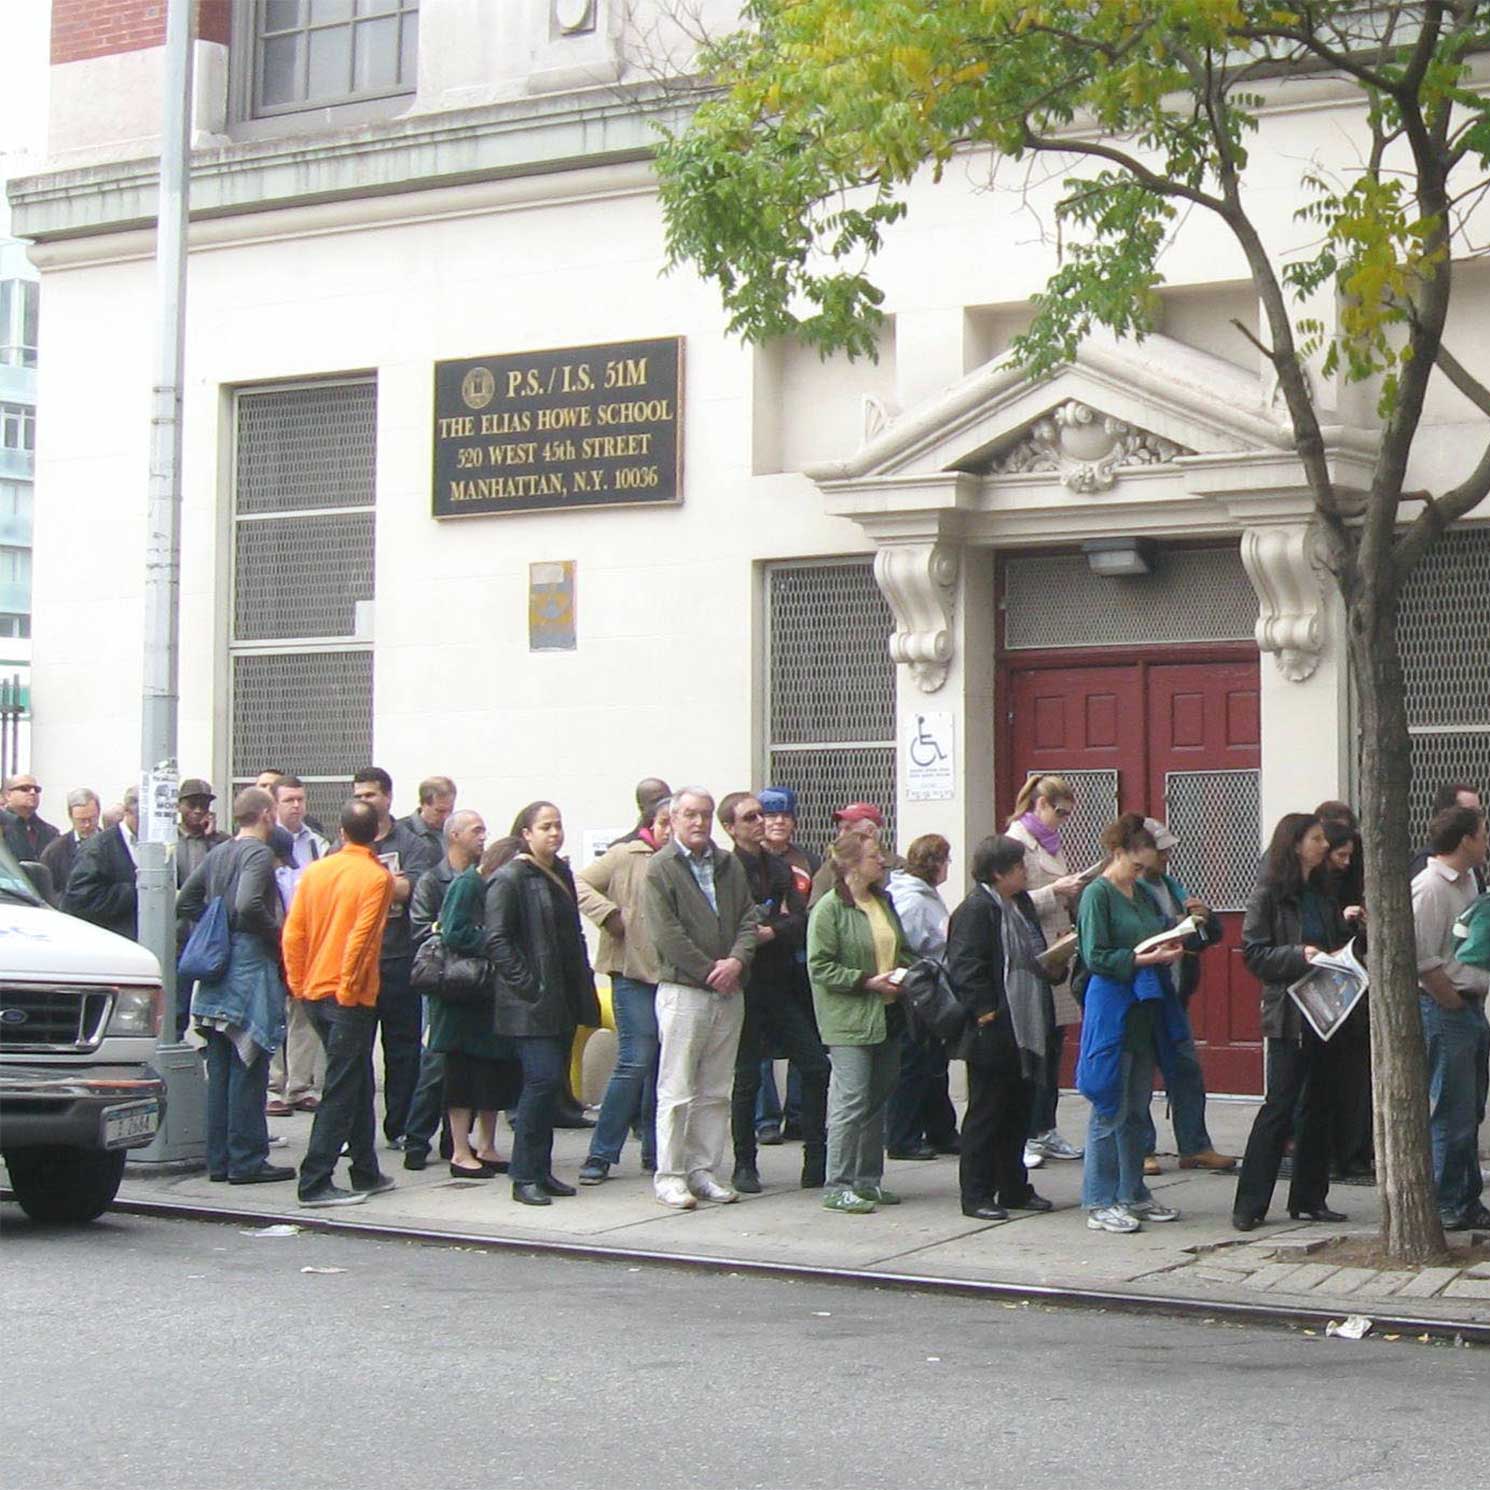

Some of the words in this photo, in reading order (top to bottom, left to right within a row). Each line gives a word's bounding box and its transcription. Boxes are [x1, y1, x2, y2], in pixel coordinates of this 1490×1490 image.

[604, 358, 648, 389] 51M
[439, 417, 475, 439] THE
[480, 411, 531, 436] ELIAS
[537, 406, 592, 431] HOWE
[597, 400, 673, 425] SCHOOL
[456, 448, 483, 469] 520
[488, 442, 538, 466] WEST
[542, 440, 576, 463] 45th
[582, 433, 652, 459] STREET
[450, 472, 568, 501] MANHATTAN,
[573, 470, 608, 492] N.Y.
[615, 466, 658, 490] 10036
